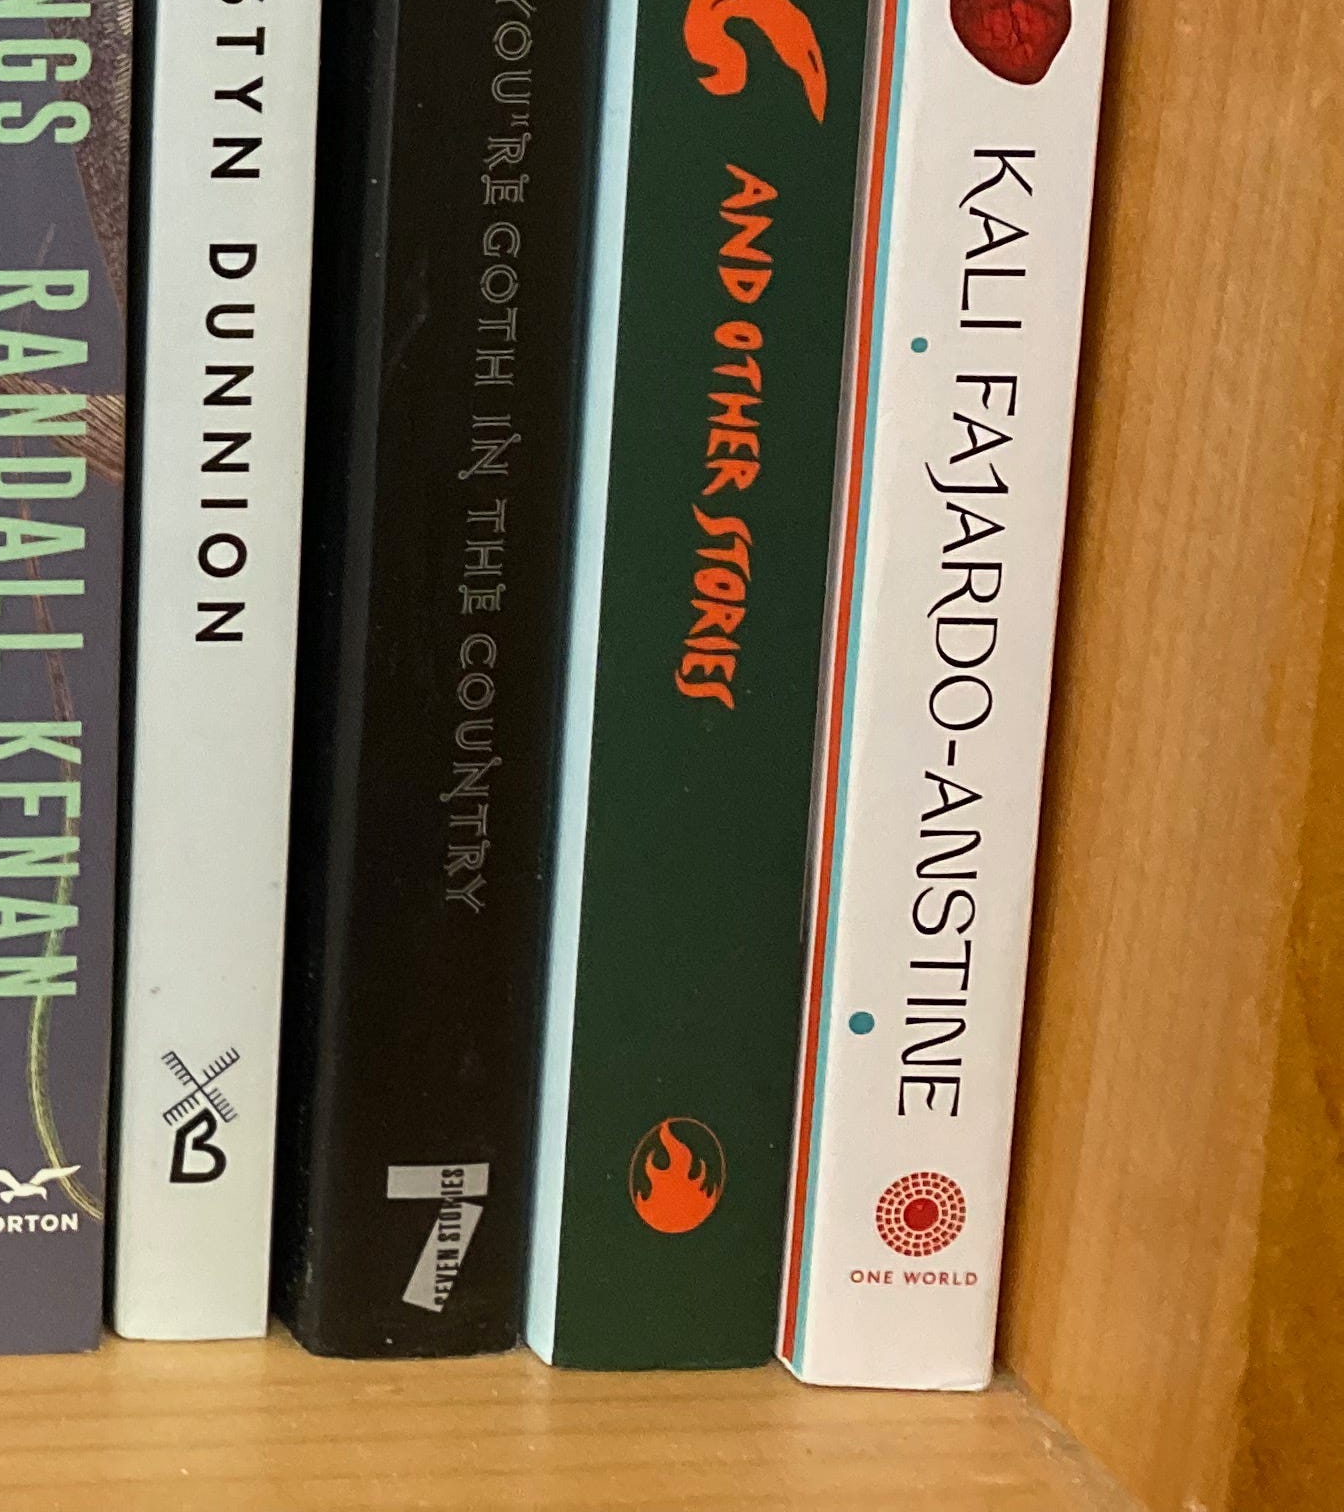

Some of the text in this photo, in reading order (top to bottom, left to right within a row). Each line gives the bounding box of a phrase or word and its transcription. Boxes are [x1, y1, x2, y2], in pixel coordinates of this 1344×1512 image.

[473, 221, 521, 387] GOTH
[719, 163, 778, 304] AND
[195, 243, 258, 644] DUNNION
[458, 414, 522, 480] IN
[707, 320, 764, 496] OTHER
[458, 498, 508, 616] THE
[675, 504, 753, 710] STORIES
[898, 149, 1036, 1118] KALI FAJARDO-ANSTINE
[439, 633, 503, 916] COUNTRY
[850, 1270, 978, 1286] ONE WORLD
